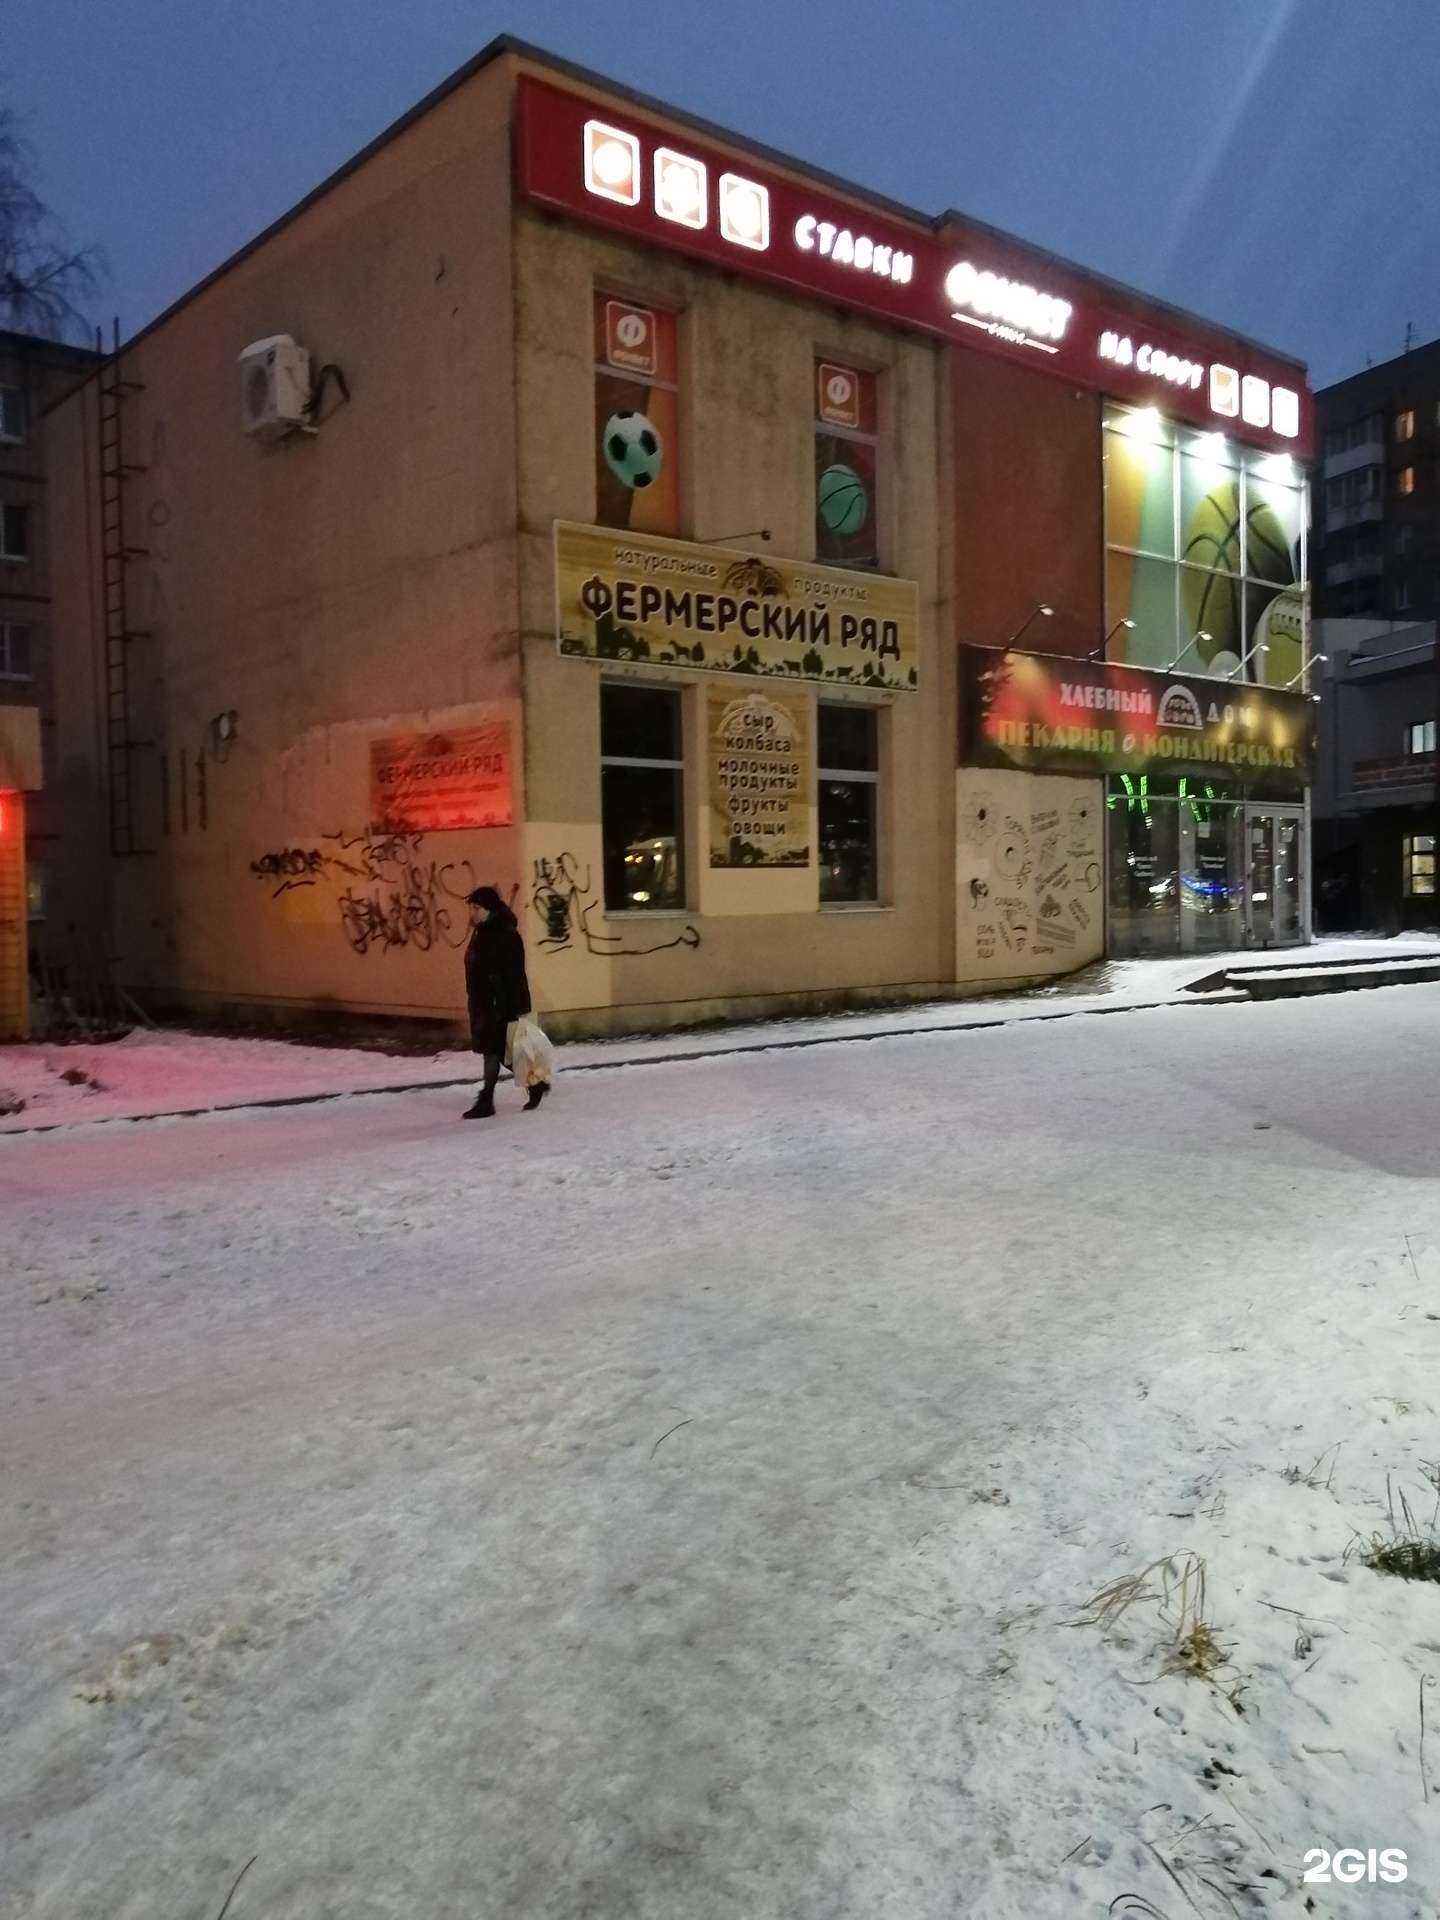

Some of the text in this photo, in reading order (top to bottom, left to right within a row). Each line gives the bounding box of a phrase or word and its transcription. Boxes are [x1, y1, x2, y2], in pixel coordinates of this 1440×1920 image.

[795, 215, 913, 284] СТАВКИ
[614, 548, 719, 578] натуральные
[793, 577, 868, 601] продукты
[582, 576, 901, 661] ФЕРМЕРСКИЙ РЯД
[1060, 683, 1152, 715] ХЛЕБНЫЙ
[725, 734, 791, 752] колбаса
[998, 719, 1114, 753] ПЕКАРНЯ
[719, 759, 799, 776] молочные
[719, 774, 798, 793] продукты
[732, 820, 786, 835] овощи
